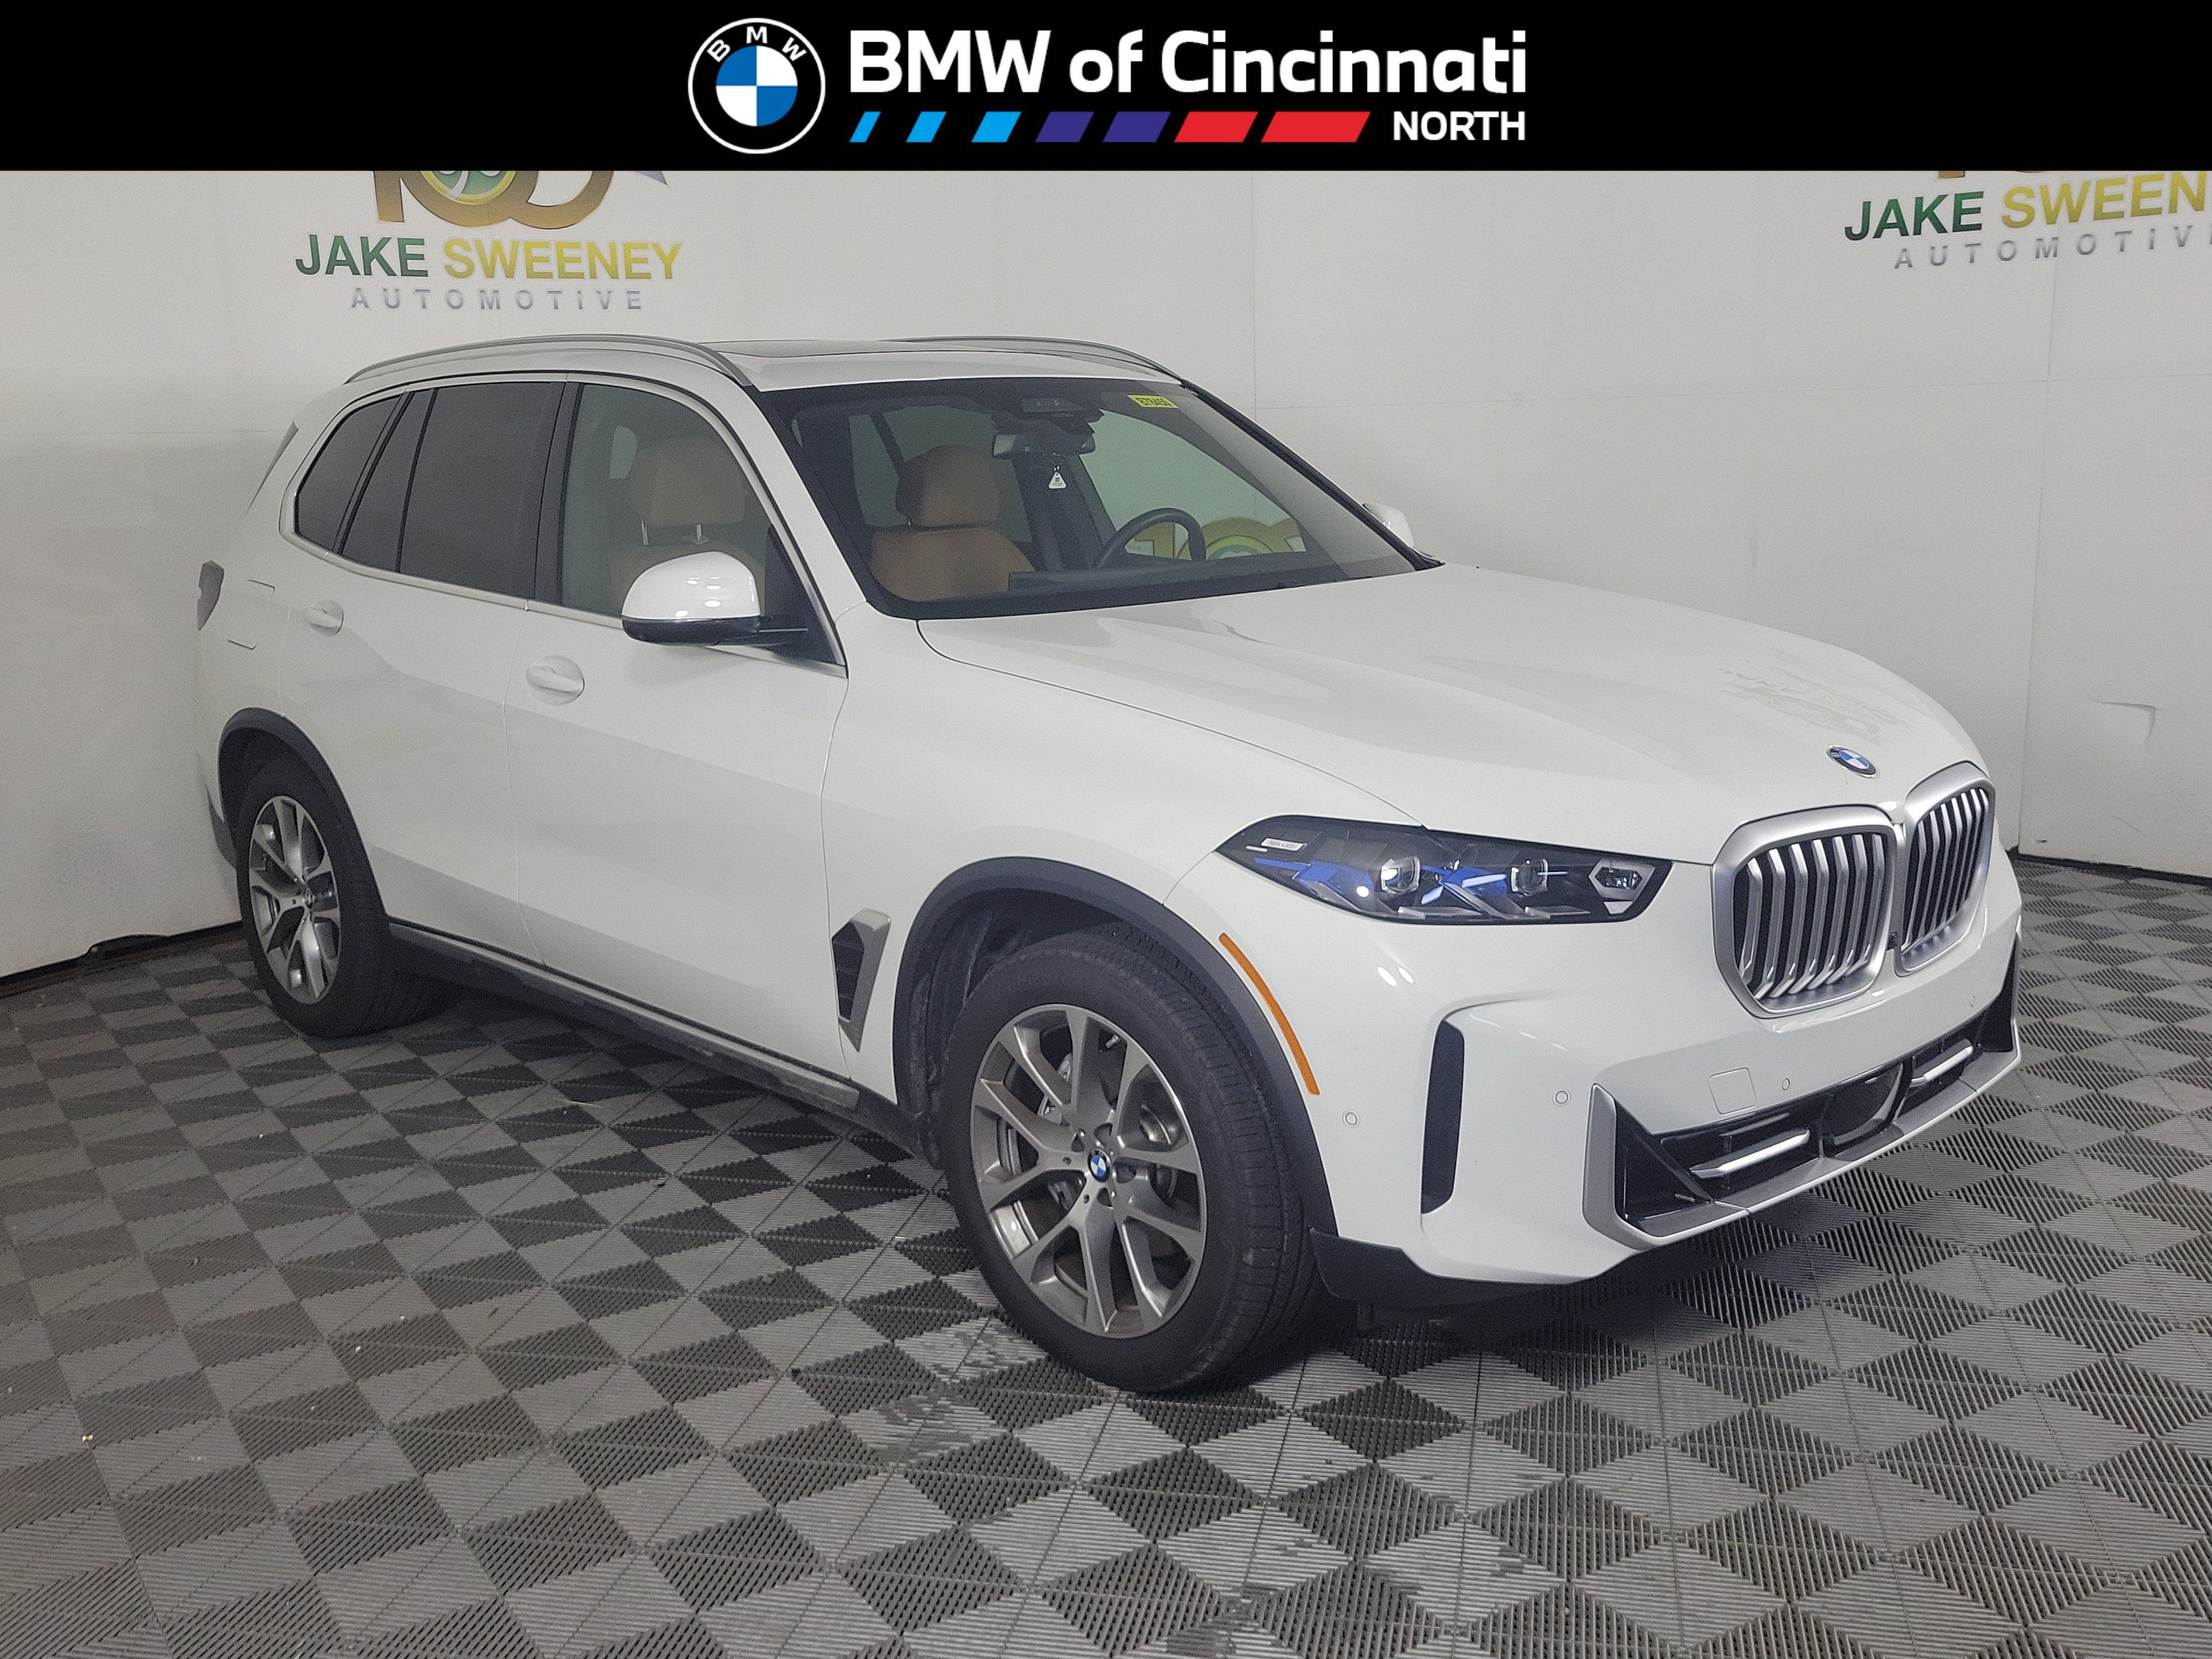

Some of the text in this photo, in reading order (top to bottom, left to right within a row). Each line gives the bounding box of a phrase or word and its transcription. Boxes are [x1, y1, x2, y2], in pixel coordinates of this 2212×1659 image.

[1844, 190, 1984, 241] JAKE
[295, 234, 682, 279] JAKE SWEENEY
[1894, 224, 2212, 269] AUTOMOTIV
[351, 287, 641, 310] AUTOMOTIVE
